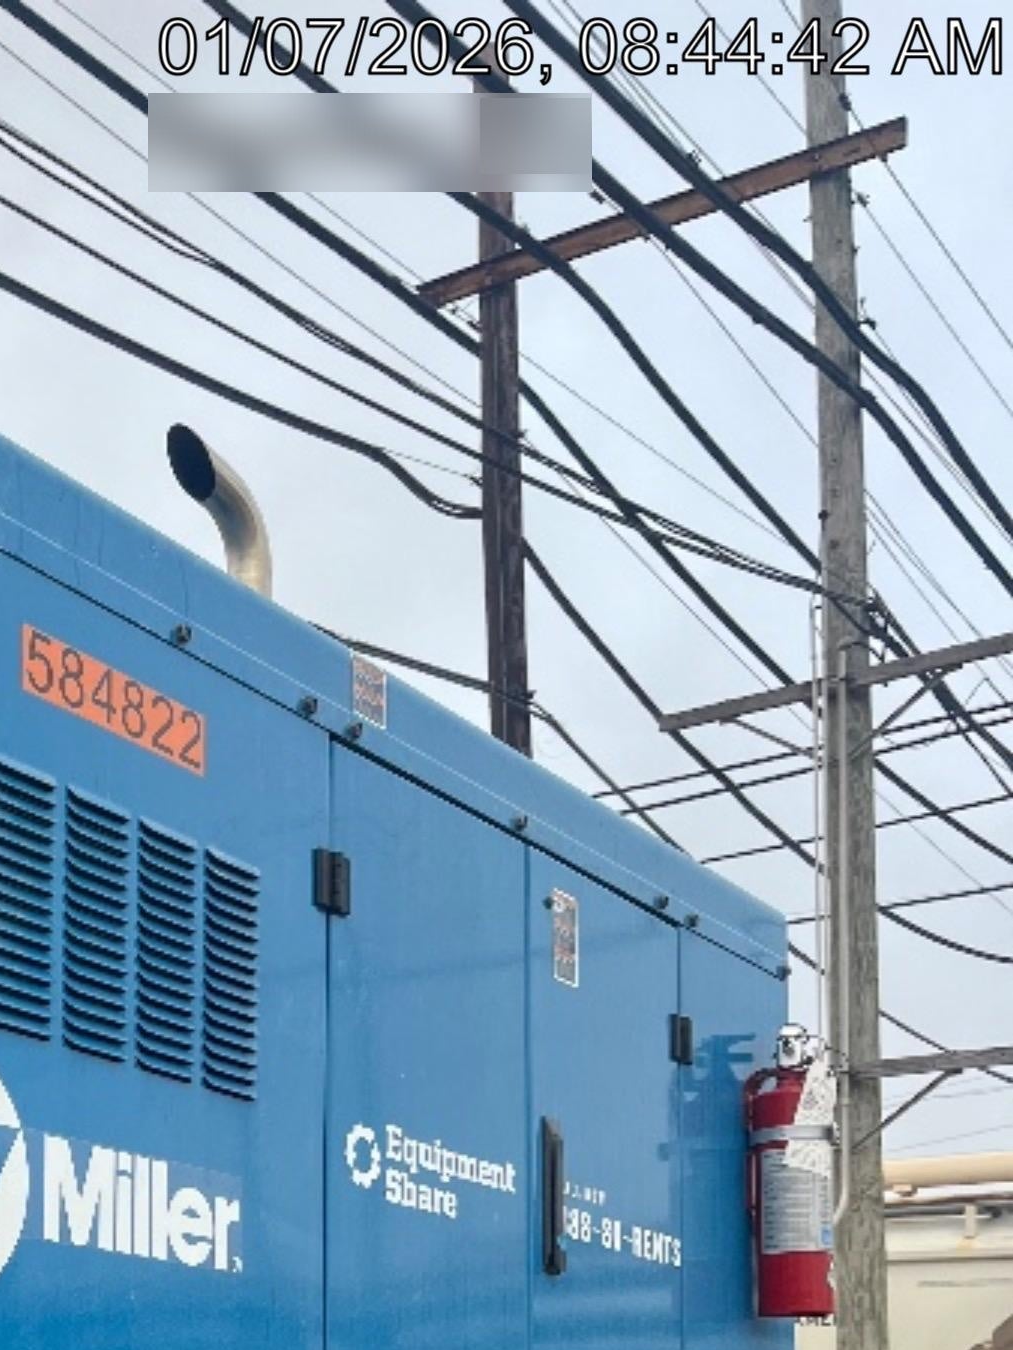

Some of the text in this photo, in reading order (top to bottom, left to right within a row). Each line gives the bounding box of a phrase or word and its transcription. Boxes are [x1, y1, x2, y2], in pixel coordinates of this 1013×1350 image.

[26, 630, 203, 769] 584822
[43, 1132, 241, 1271] Miller
[385, 1123, 517, 1193] Equipment
[385, 1169, 458, 1219] Share
